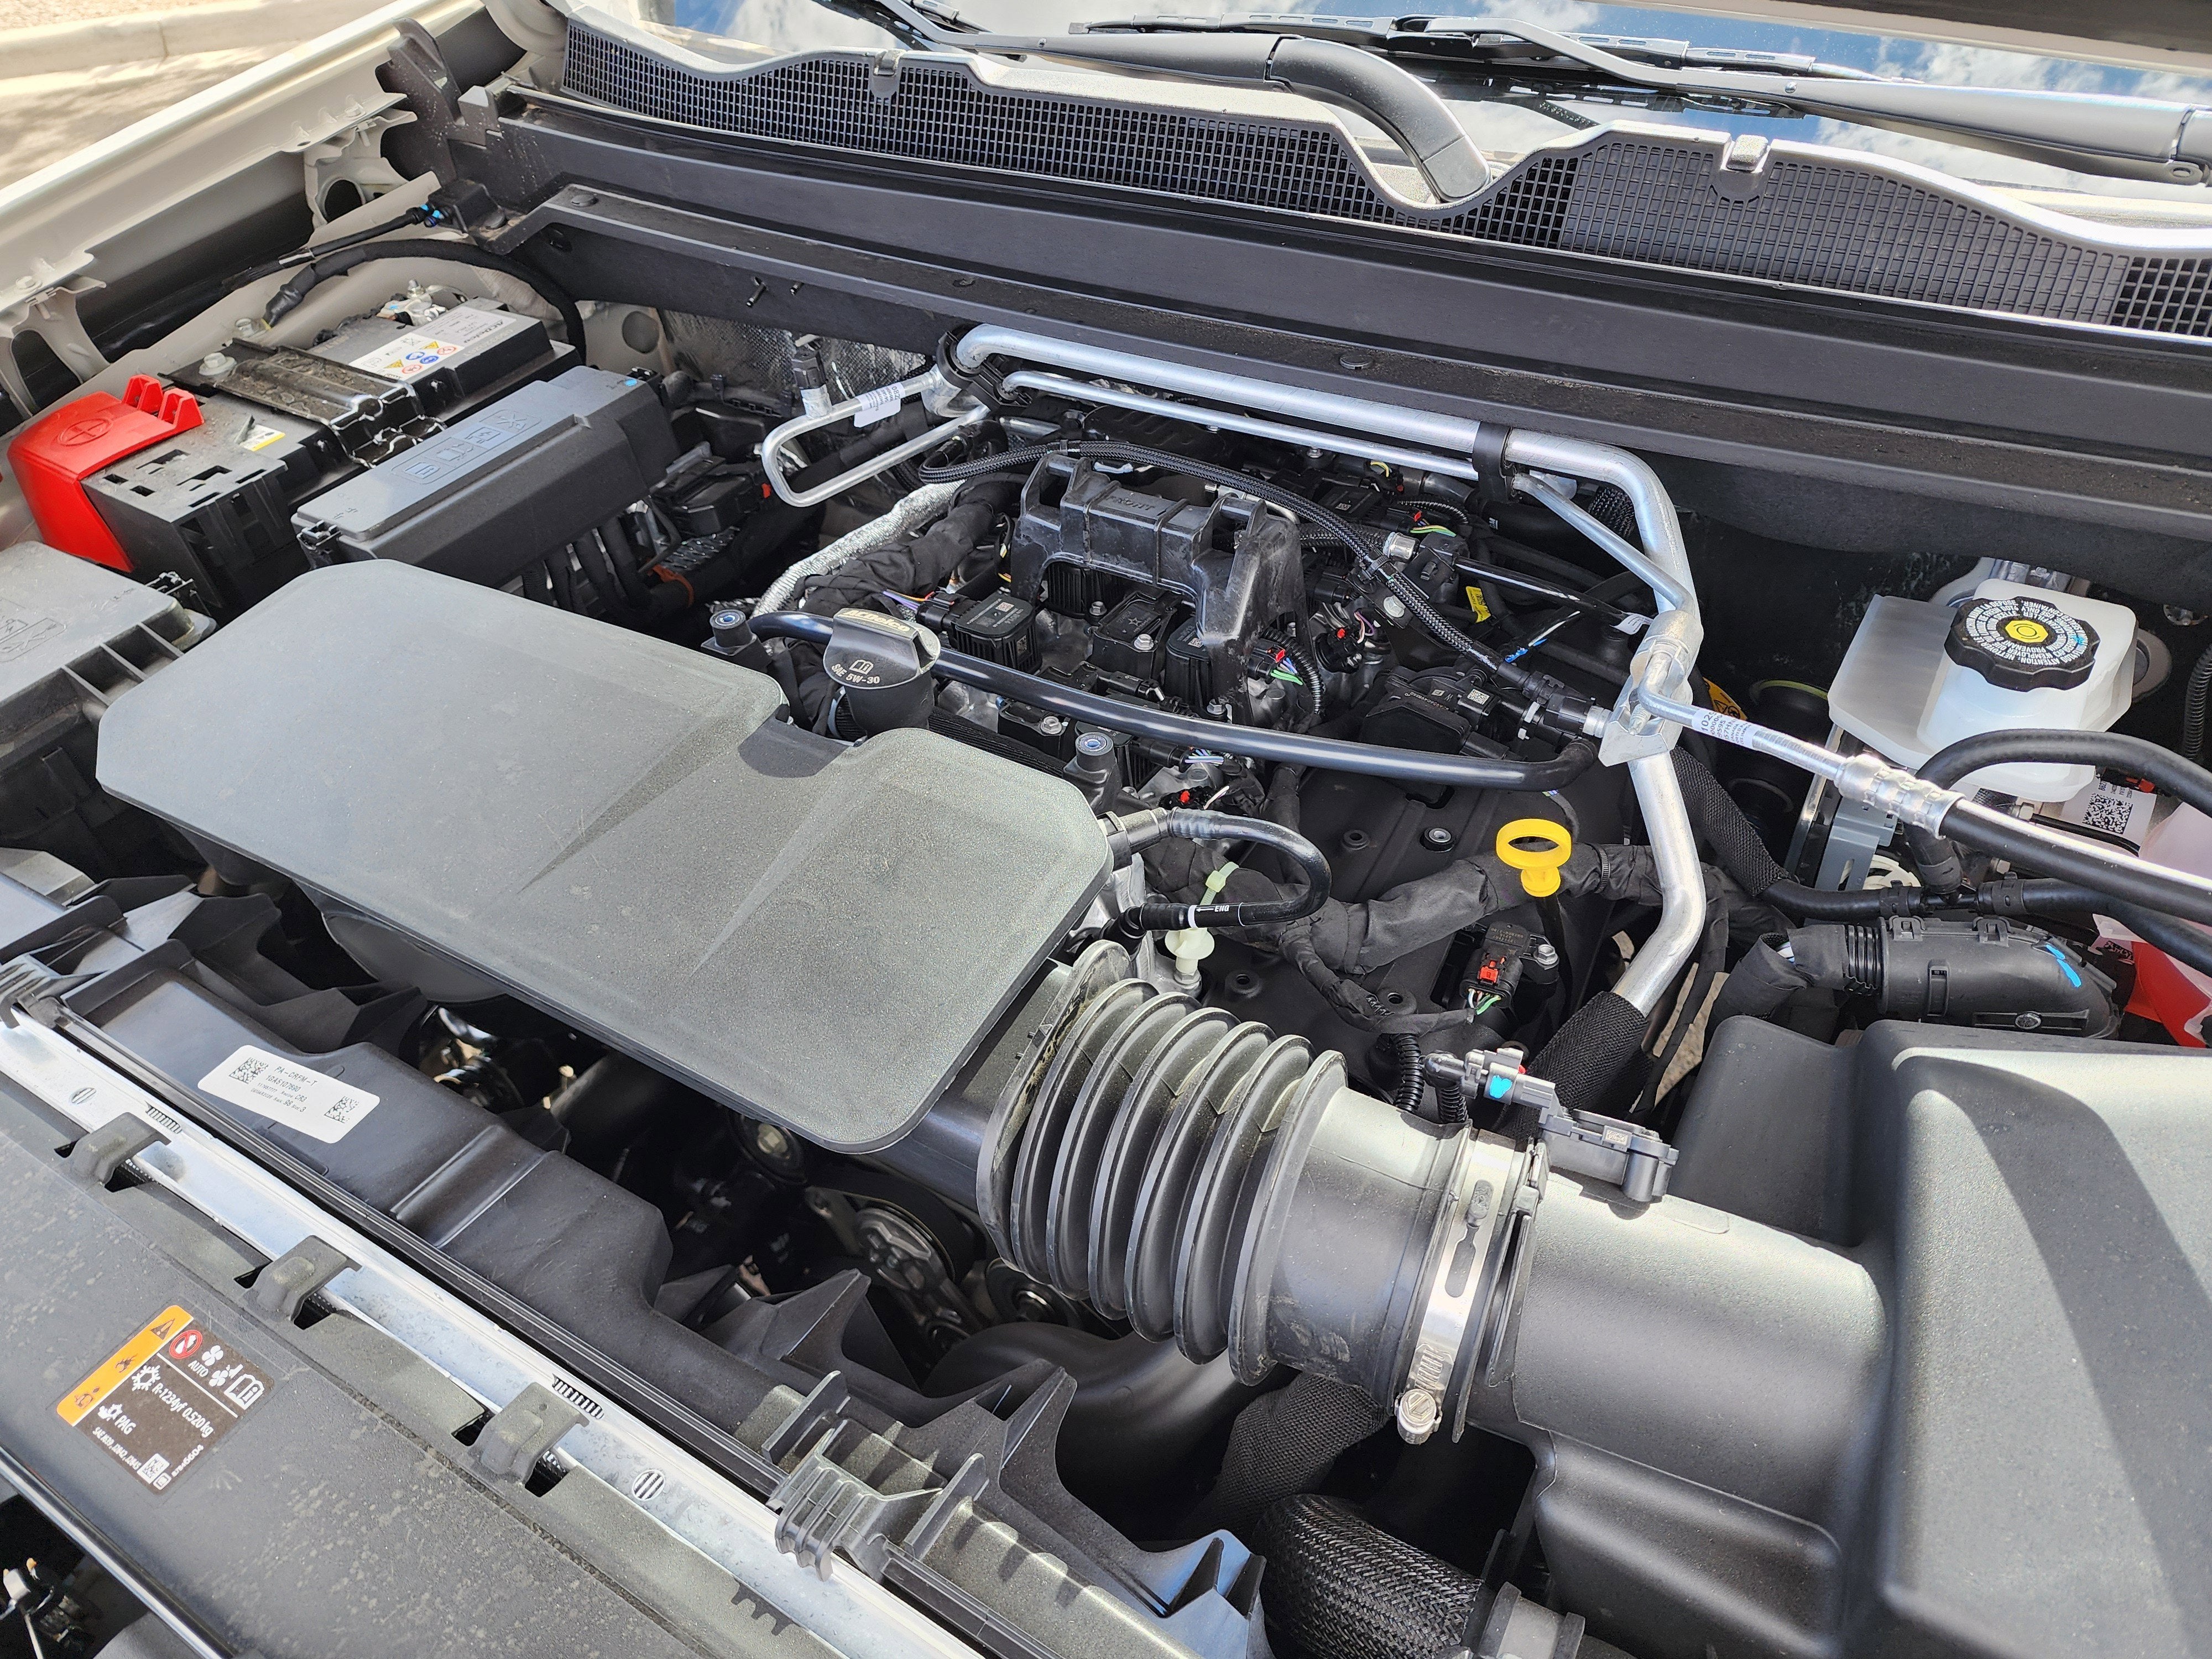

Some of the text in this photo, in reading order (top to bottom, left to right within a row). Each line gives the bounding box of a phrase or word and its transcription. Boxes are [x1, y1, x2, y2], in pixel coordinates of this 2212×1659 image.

[1981, 607, 2002, 617] FREIN
[2020, 606, 2041, 614] ONLY
[2022, 611, 2051, 623] FILLER
[2039, 609, 2056, 619] USE
[843, 609, 911, 633] ACDelco
[2044, 619, 2065, 633] CLEAN
[2059, 614, 2084, 630] SEALED
[1980, 641, 2015, 660] NETTOYER
[1990, 641, 2008, 651] QUE
[2000, 639, 2048, 653] PROVENANT
[2070, 644, 2088, 656] FLUID
[2051, 649, 2068, 658] CAP
[831, 663, 880, 685] SAE 5W-30
[274, 1066, 317, 1087] PA-CRFM-T
[188, 1360, 209, 1378] AUTO
[152, 1383, 188, 1412] R-1234yf
[114, 1415, 137, 1435] PAG
[92, 1426, 106, 1439] SAE
